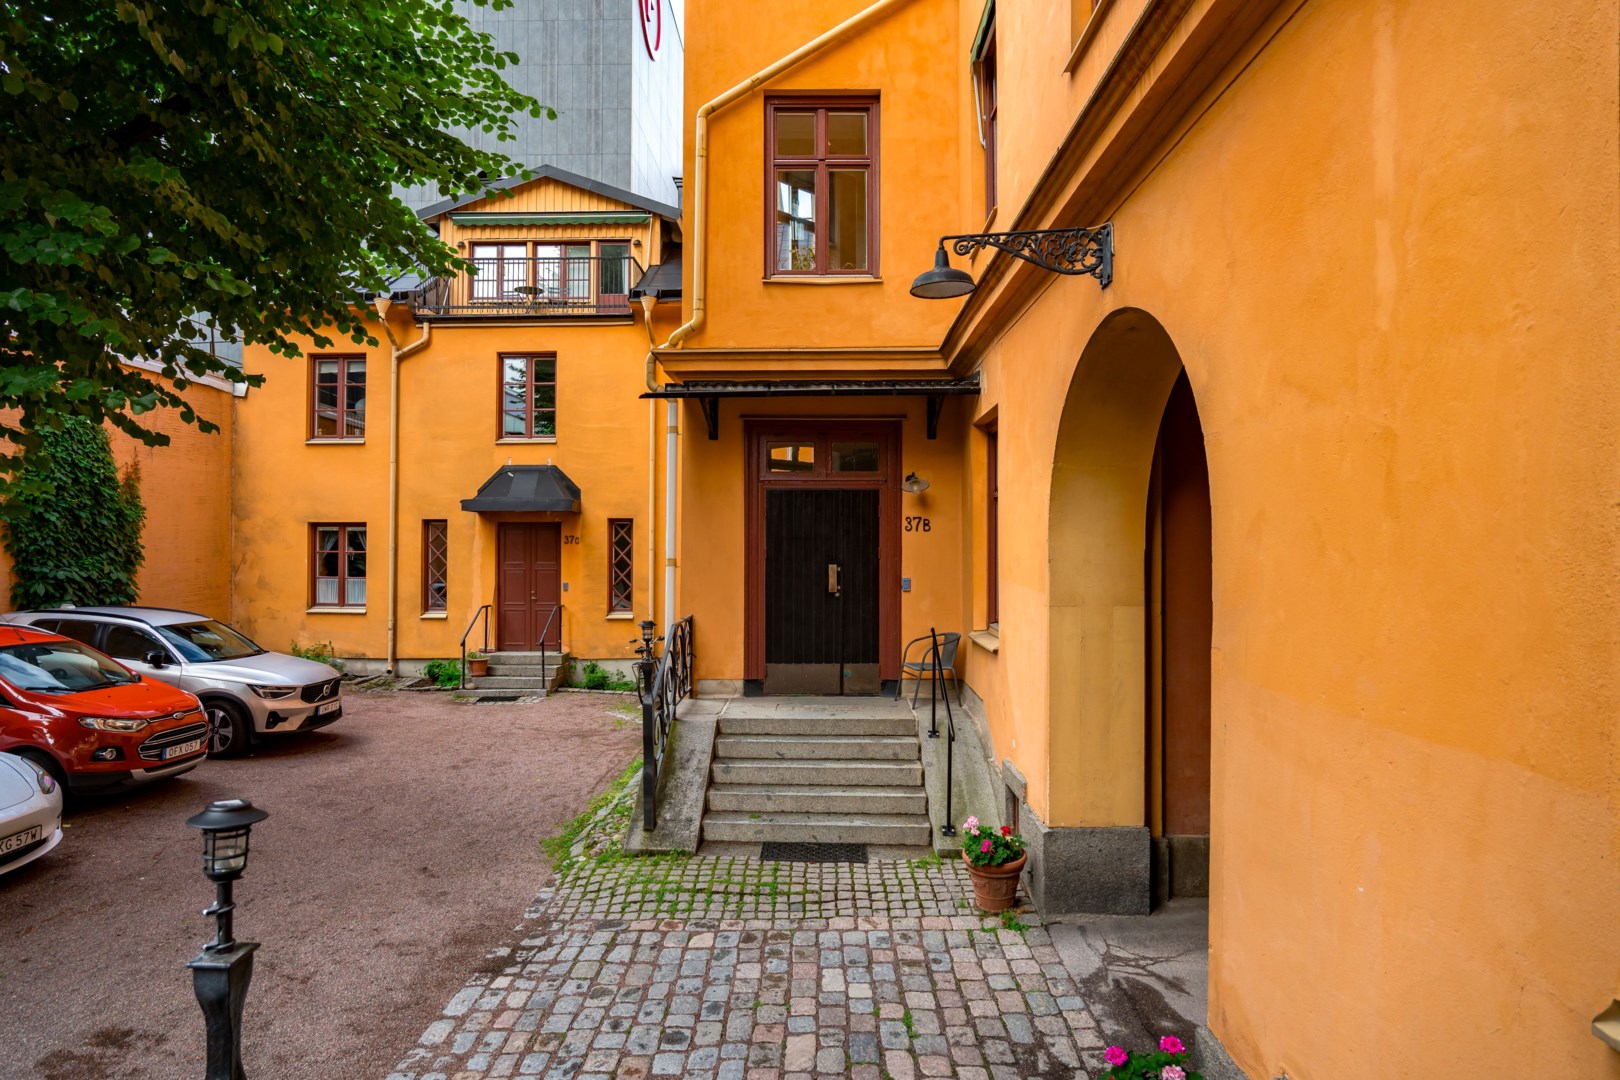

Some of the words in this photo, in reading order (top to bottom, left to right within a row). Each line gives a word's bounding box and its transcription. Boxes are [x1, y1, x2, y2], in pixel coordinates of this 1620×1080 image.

[904, 516, 931, 532] 37B
[168, 745, 184, 757] OFX
[184, 741, 199, 752] 057
[16, 828, 37, 847] 57W
